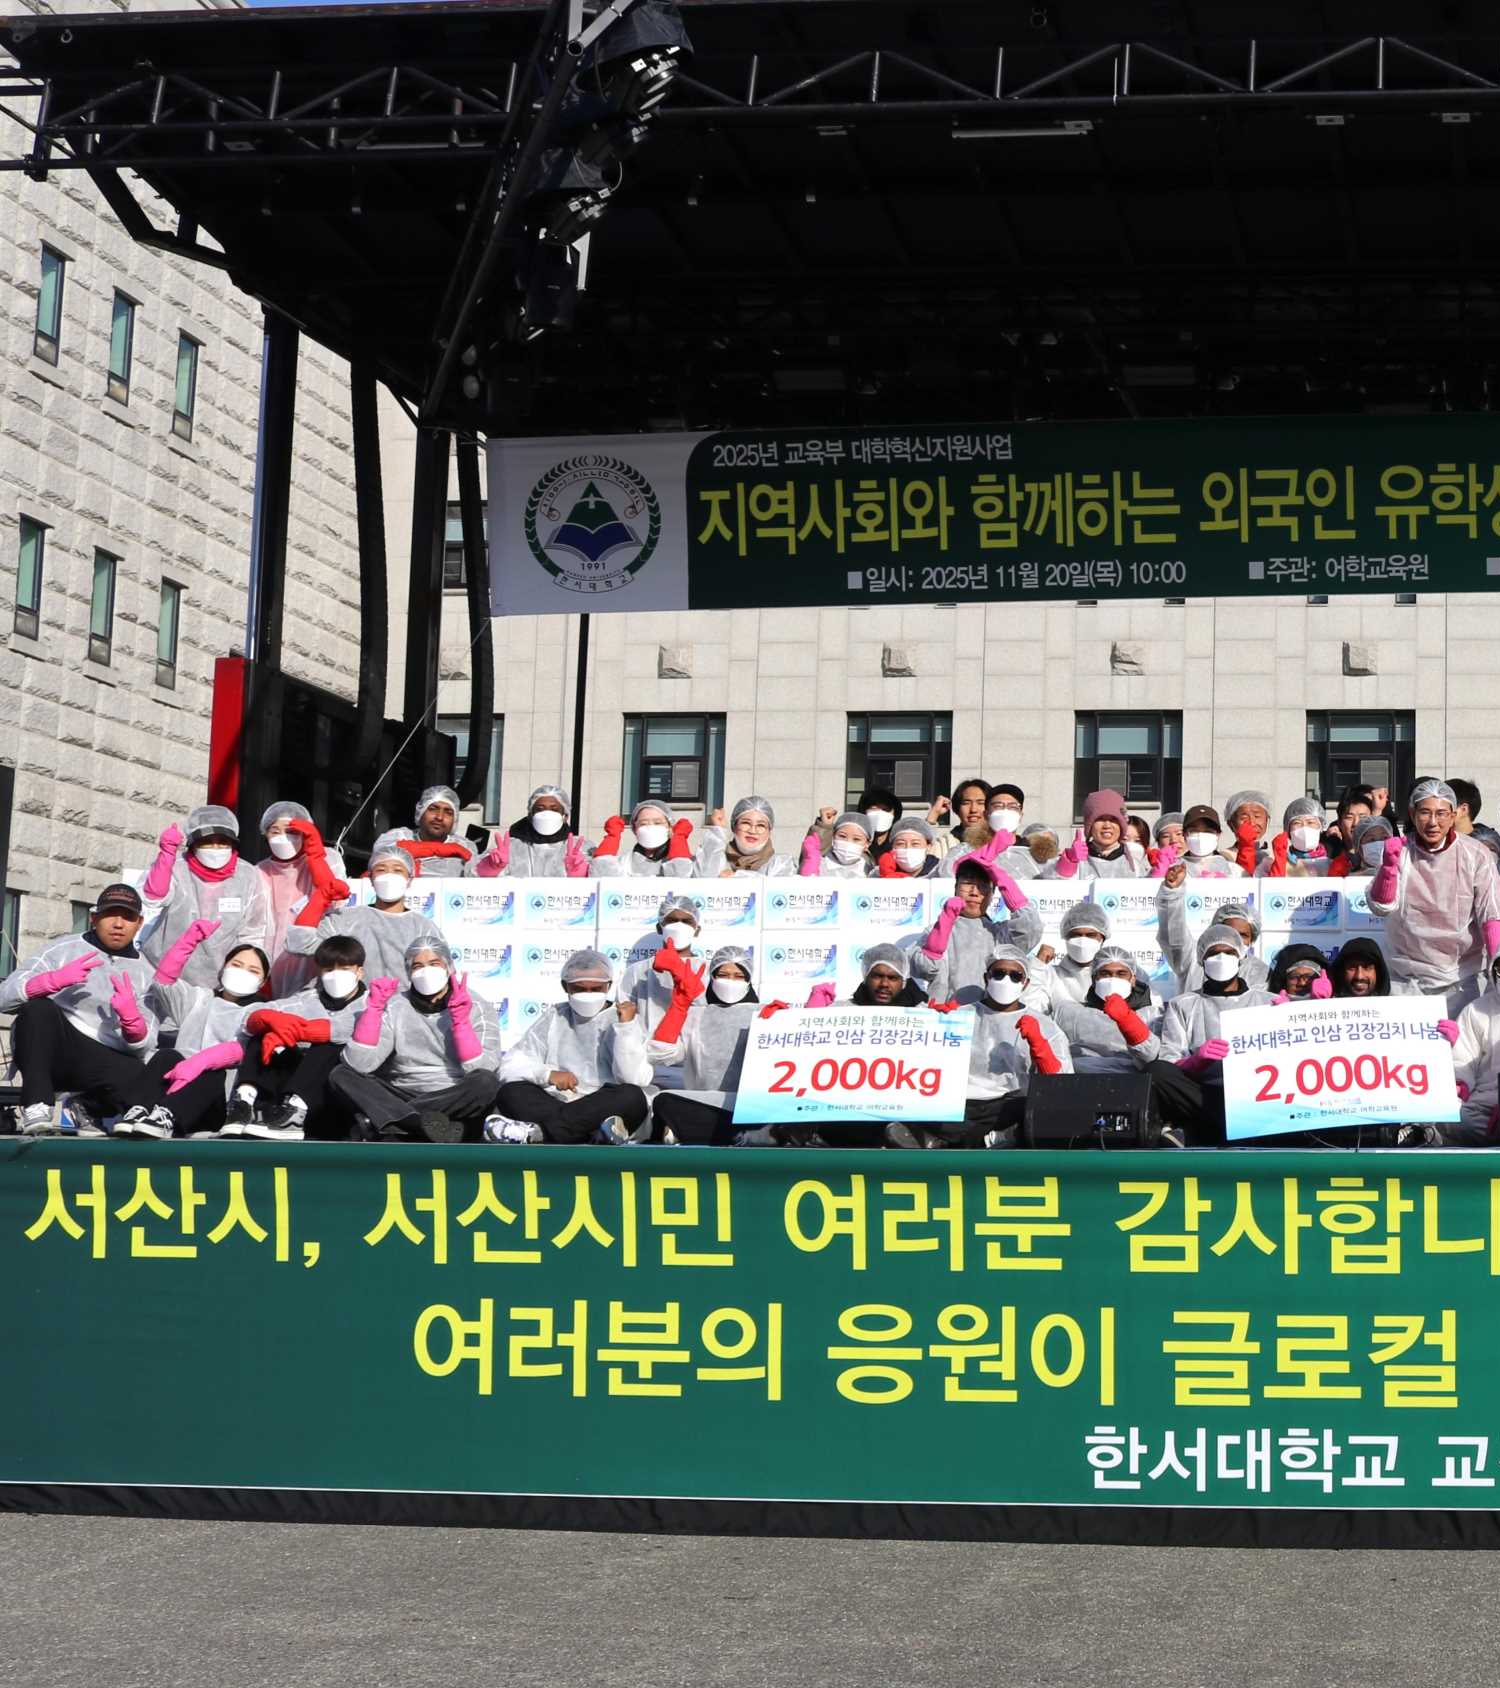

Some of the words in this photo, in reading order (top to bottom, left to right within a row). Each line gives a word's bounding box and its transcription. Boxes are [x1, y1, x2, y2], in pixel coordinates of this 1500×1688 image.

[711, 441, 779, 467] 2025년
[784, 439, 846, 466] 교육부
[851, 433, 1013, 464] 대학혁신지원사업
[698, 476, 956, 557] 지역사회와
[970, 473, 1181, 550] 함께하는
[1199, 466, 1357, 542] 외국인
[920, 566, 988, 590] 2025년
[996, 562, 1039, 589] 11월
[1045, 560, 1124, 589] 20일(목)
[1129, 561, 1187, 585] 10:00
[1324, 554, 1430, 582] 어학교육원
[1288, 895, 1332, 907] 한서대학교
[799, 1015, 865, 1028] 지역사회와
[871, 1015, 925, 1028] 함께하는
[1287, 1011, 1338, 1023] 지역사회와
[1341, 1009, 1381, 1020] 함께하는
[757, 1030, 832, 1050] 한서대학교
[835, 1029, 865, 1046] 인삼
[868, 1029, 929, 1046] 김장김치
[933, 1031, 964, 1047] 나눔
[1231, 1026, 1308, 1055] 한서대학교
[1311, 1024, 1342, 1043] 인삼
[1345, 1022, 1407, 1041] 김장김치
[768, 1057, 942, 1097] 2,000kg
[1255, 1054, 1429, 1105] 2,000kg
[24, 1163, 322, 1268] 서산시,
[363, 1167, 736, 1268] 서산시민
[783, 1173, 1073, 1272] 여러분
[412, 1296, 784, 1402] 여러분의
[826, 1302, 1117, 1407] 응원이
[1162, 1308, 1459, 1409] 글로컬
[1084, 1425, 1406, 1494] 한서대학교
